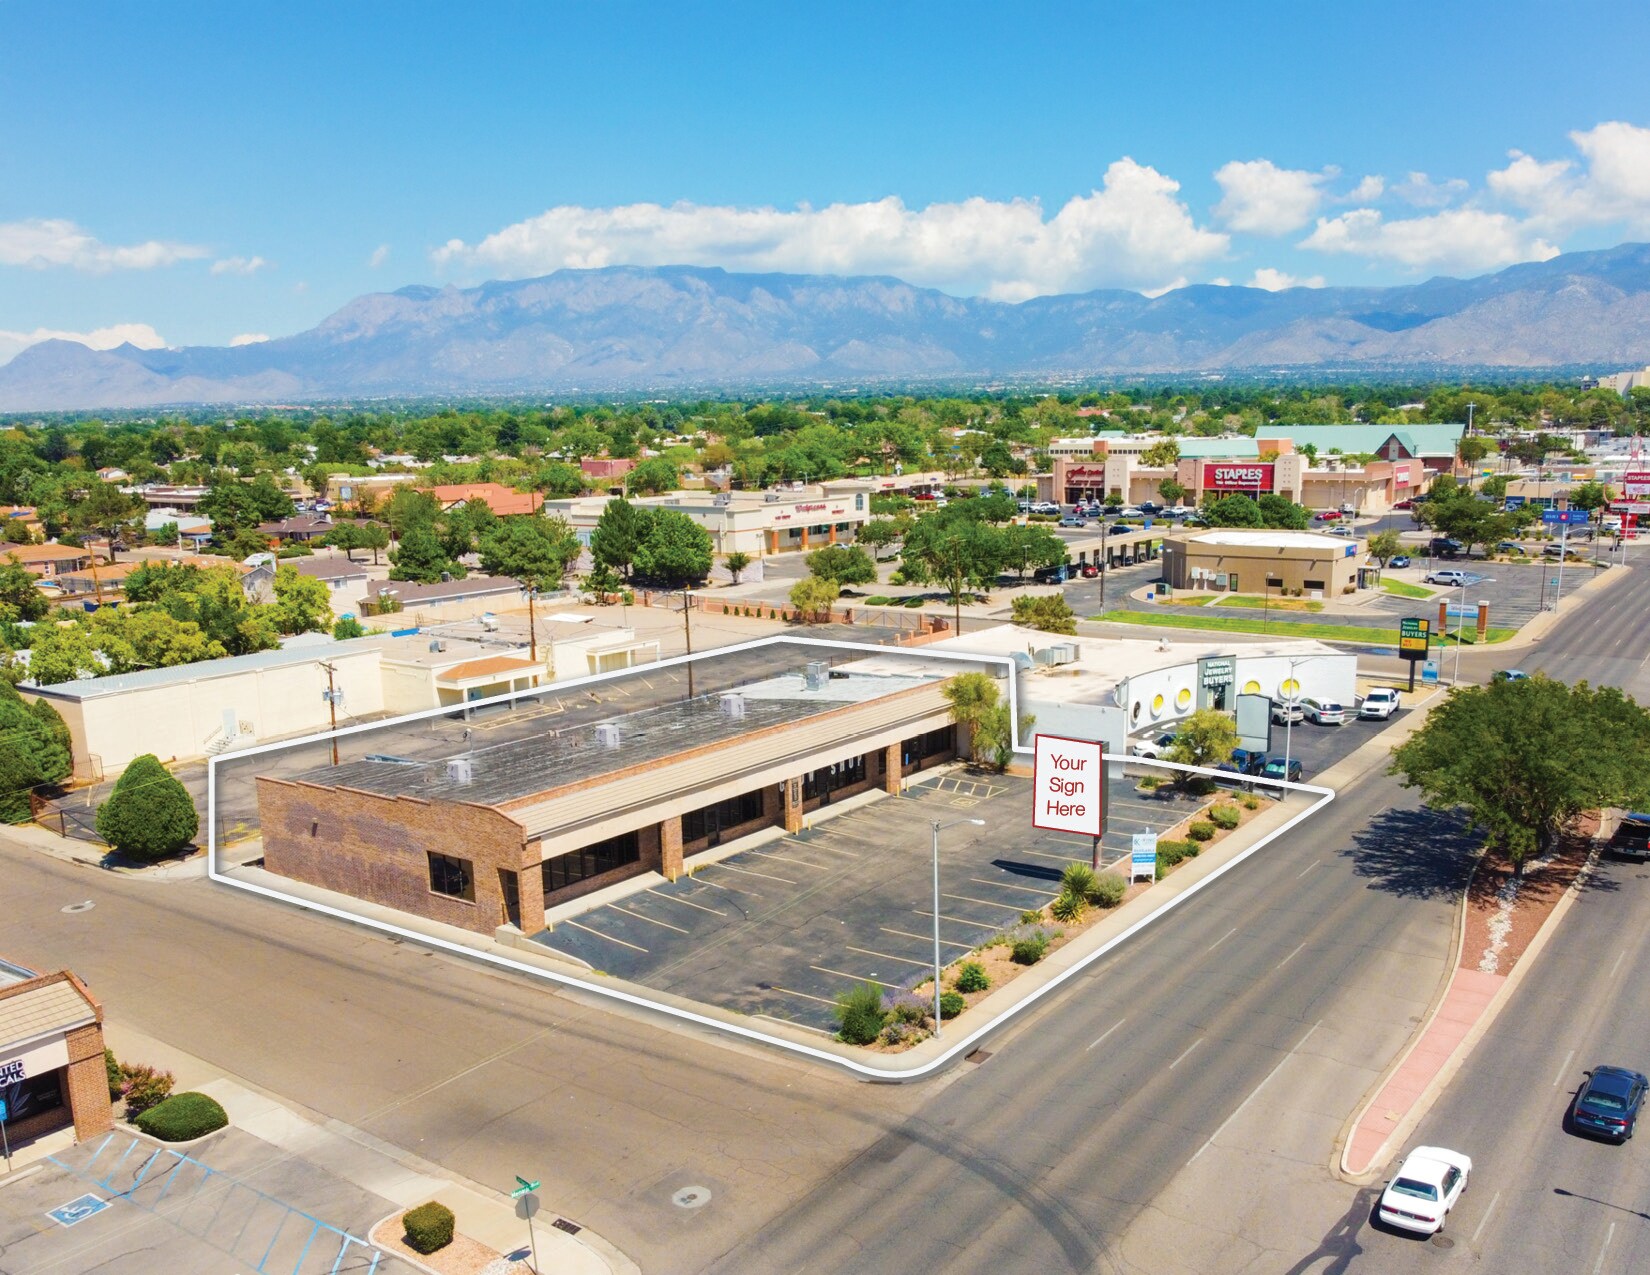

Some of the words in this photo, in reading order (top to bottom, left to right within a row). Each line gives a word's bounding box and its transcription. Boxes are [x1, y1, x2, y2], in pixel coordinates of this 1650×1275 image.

[1215, 468, 1263, 480] STAPLES
[1204, 667, 1233, 675] JEWELRY
[1203, 675, 1234, 685] BUYERS
[0, 1070, 26, 1088] CALS
